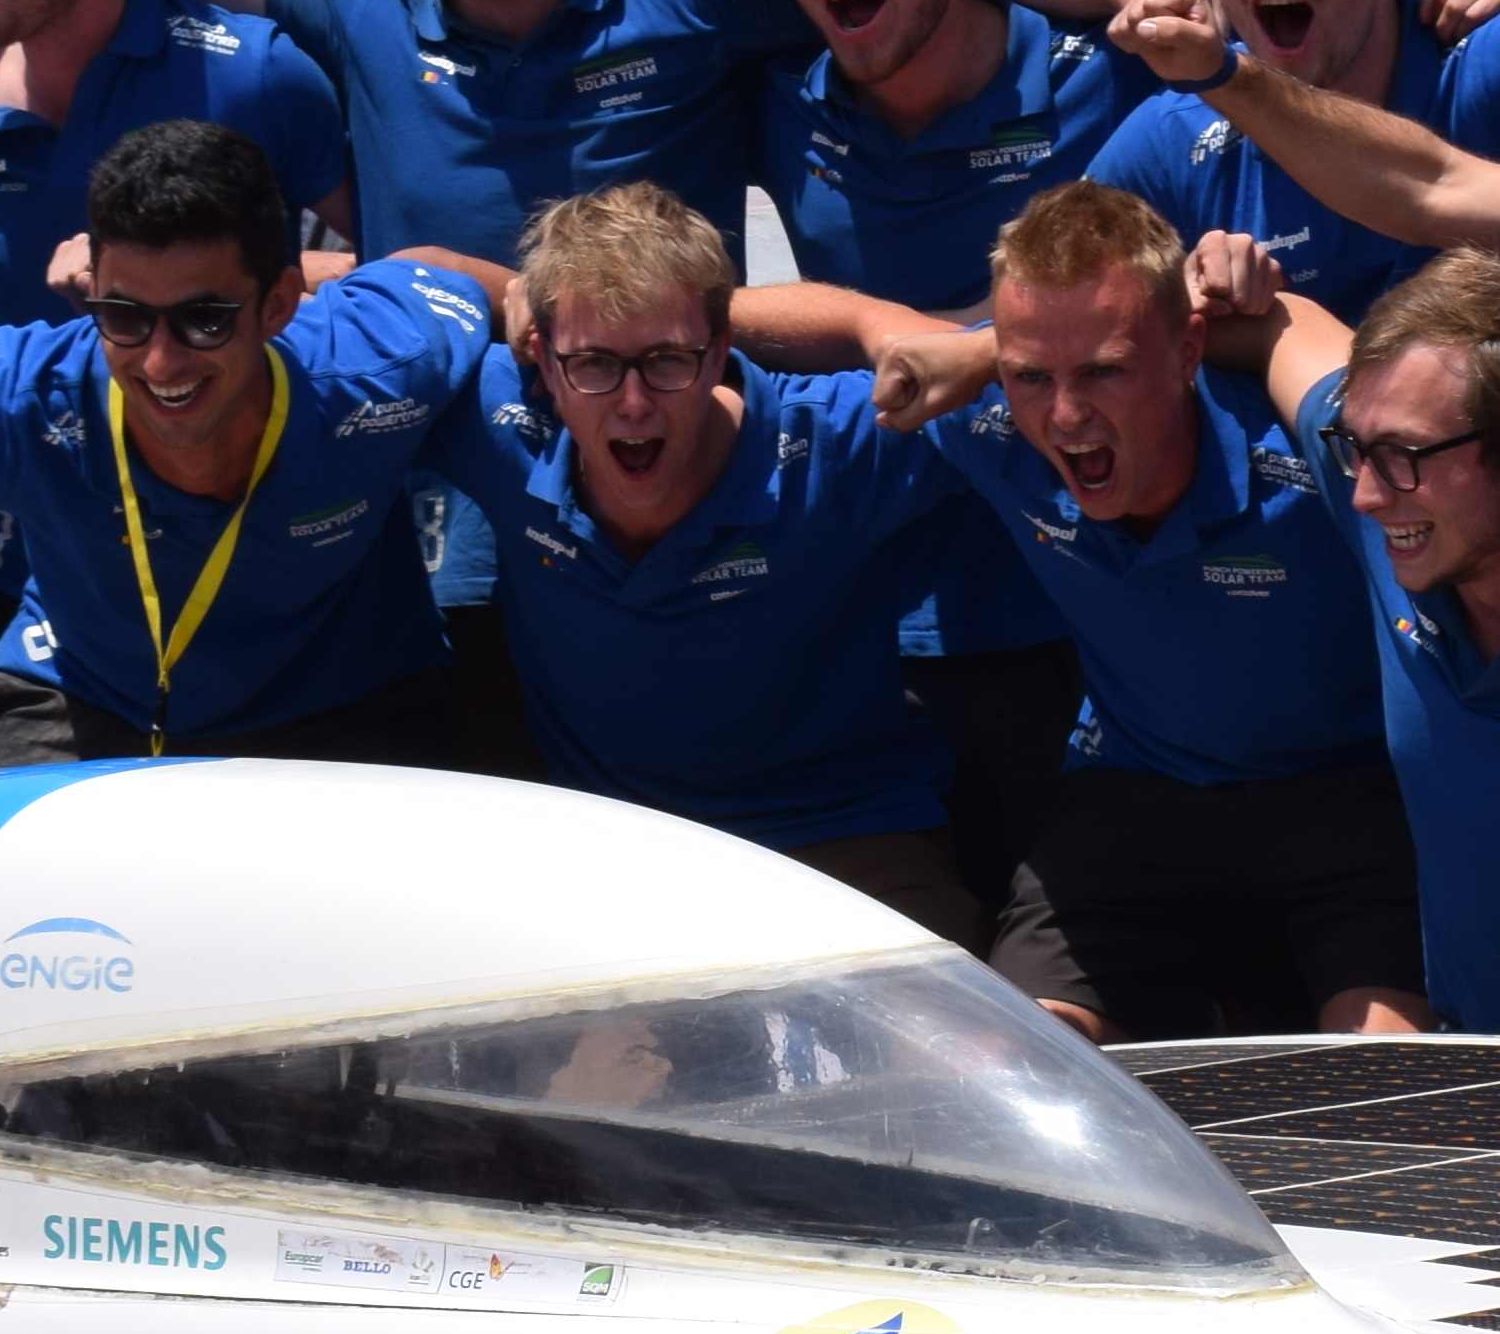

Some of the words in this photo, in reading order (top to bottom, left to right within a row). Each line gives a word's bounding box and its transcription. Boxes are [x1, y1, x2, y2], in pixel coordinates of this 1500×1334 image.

[575, 72, 617, 94] SOLAR
[620, 64, 659, 84] TEAM
[969, 155, 1012, 170] SOLAR
[1014, 146, 1053, 164] TEAM
[42, 1214, 228, 1271] SIEMENS
[283, 1250, 325, 1265] Europcar
[343, 1258, 392, 1276] BELLO
[448, 1270, 486, 1290] CGE
[581, 1281, 610, 1294] SQM
